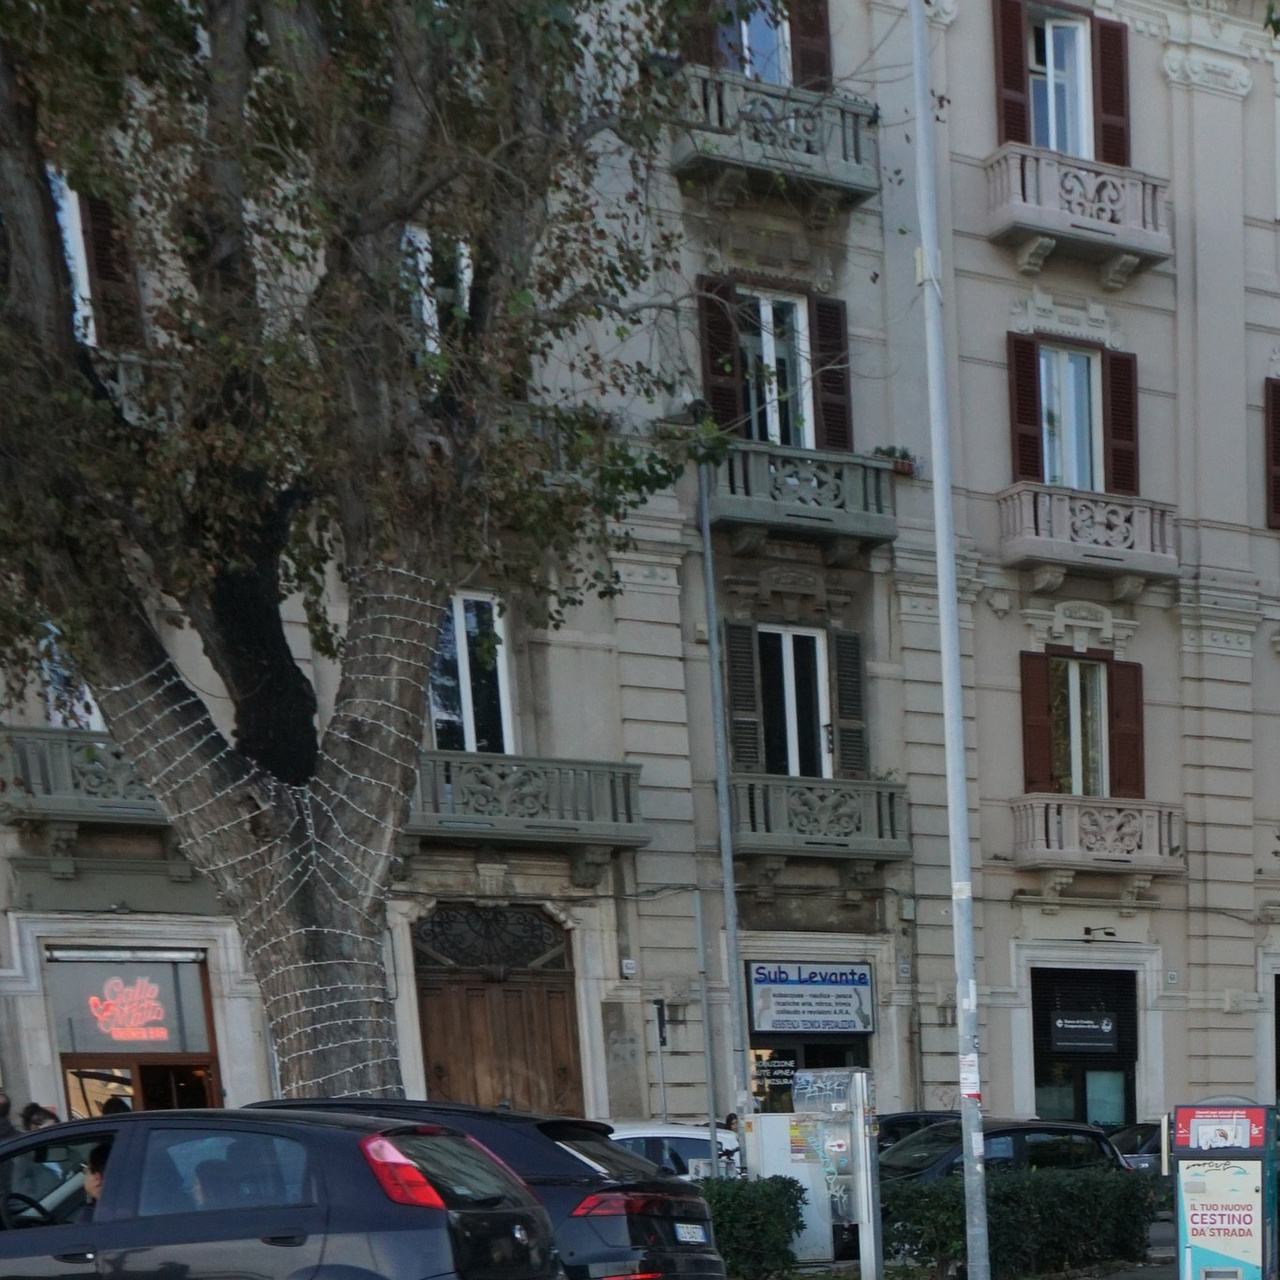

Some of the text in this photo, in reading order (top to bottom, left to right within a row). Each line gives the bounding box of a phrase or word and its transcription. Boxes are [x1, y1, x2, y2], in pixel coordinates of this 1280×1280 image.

[755, 965, 868, 984] Sub Levante
[1190, 1213, 1253, 1225] CESTINO
[1191, 1228, 1253, 1237] DA STRADA
